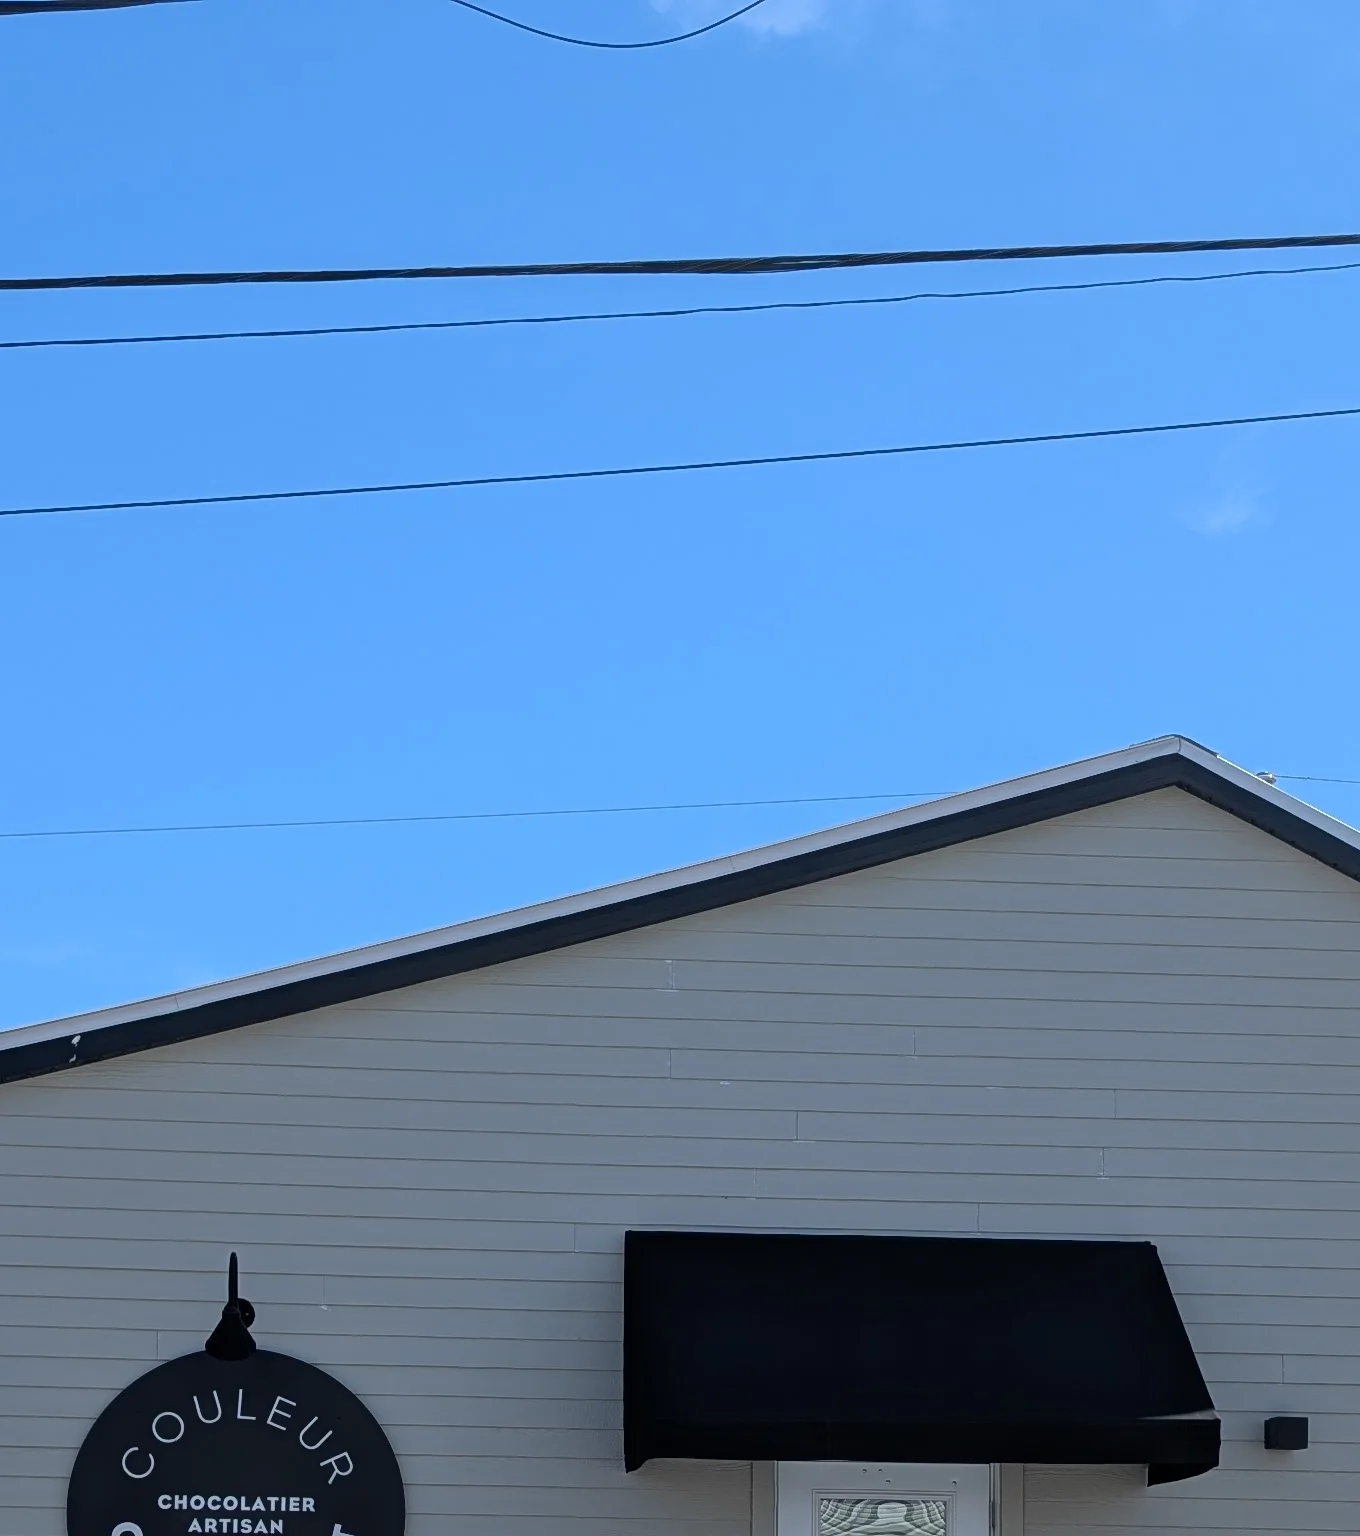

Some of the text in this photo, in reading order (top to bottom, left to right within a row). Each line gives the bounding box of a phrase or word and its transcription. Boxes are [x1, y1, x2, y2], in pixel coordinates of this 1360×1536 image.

[121, 1388, 354, 1485] COULEUR
[157, 1494, 316, 1513] CHOCOLATIER
[187, 1517, 284, 1535] ARTISAN
